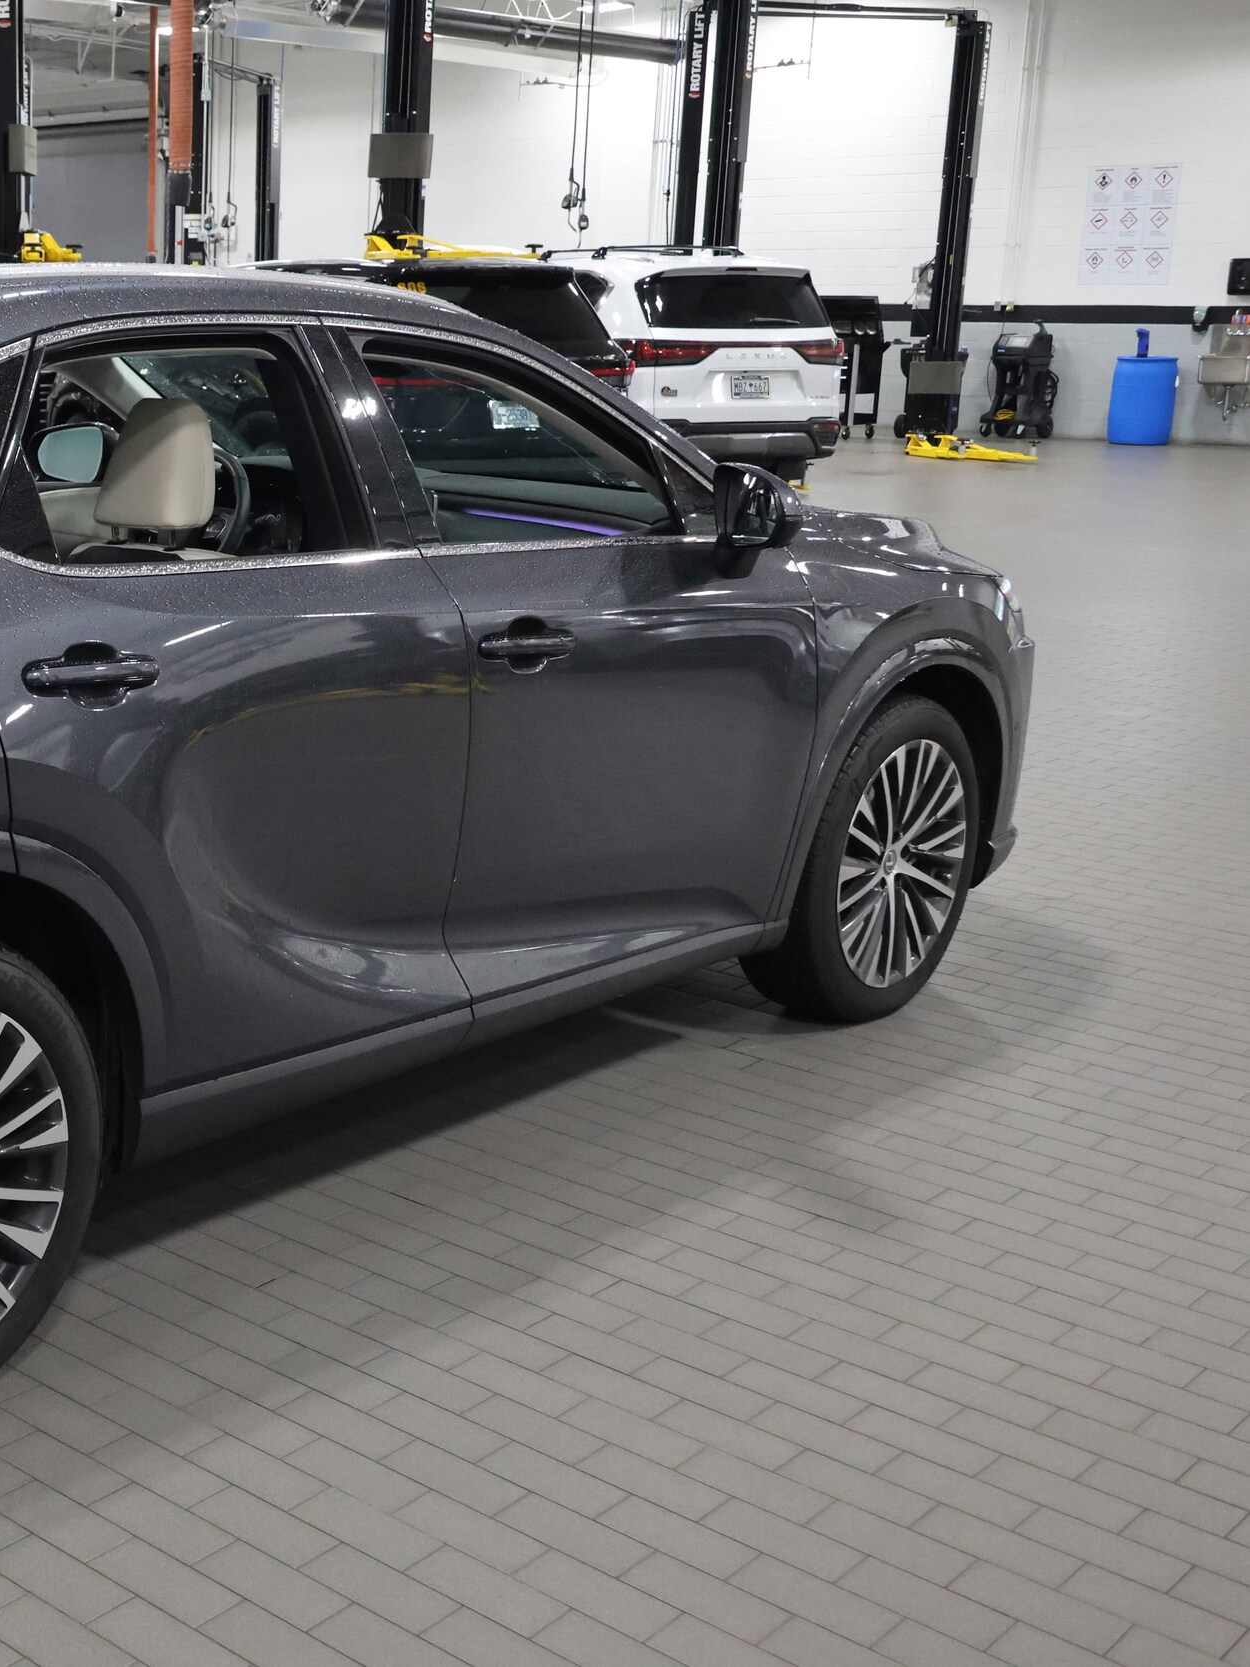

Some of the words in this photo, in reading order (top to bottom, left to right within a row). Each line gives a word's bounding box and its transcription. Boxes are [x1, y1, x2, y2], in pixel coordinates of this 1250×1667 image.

[694, 12, 705, 38] LIFT
[746, 16, 756, 71] ROTARY
[690, 42, 703, 91] ROTARY
[979, 51, 989, 100] ROTARY
[734, 382, 747, 392] MBZ
[754, 382, 766, 392] 667
